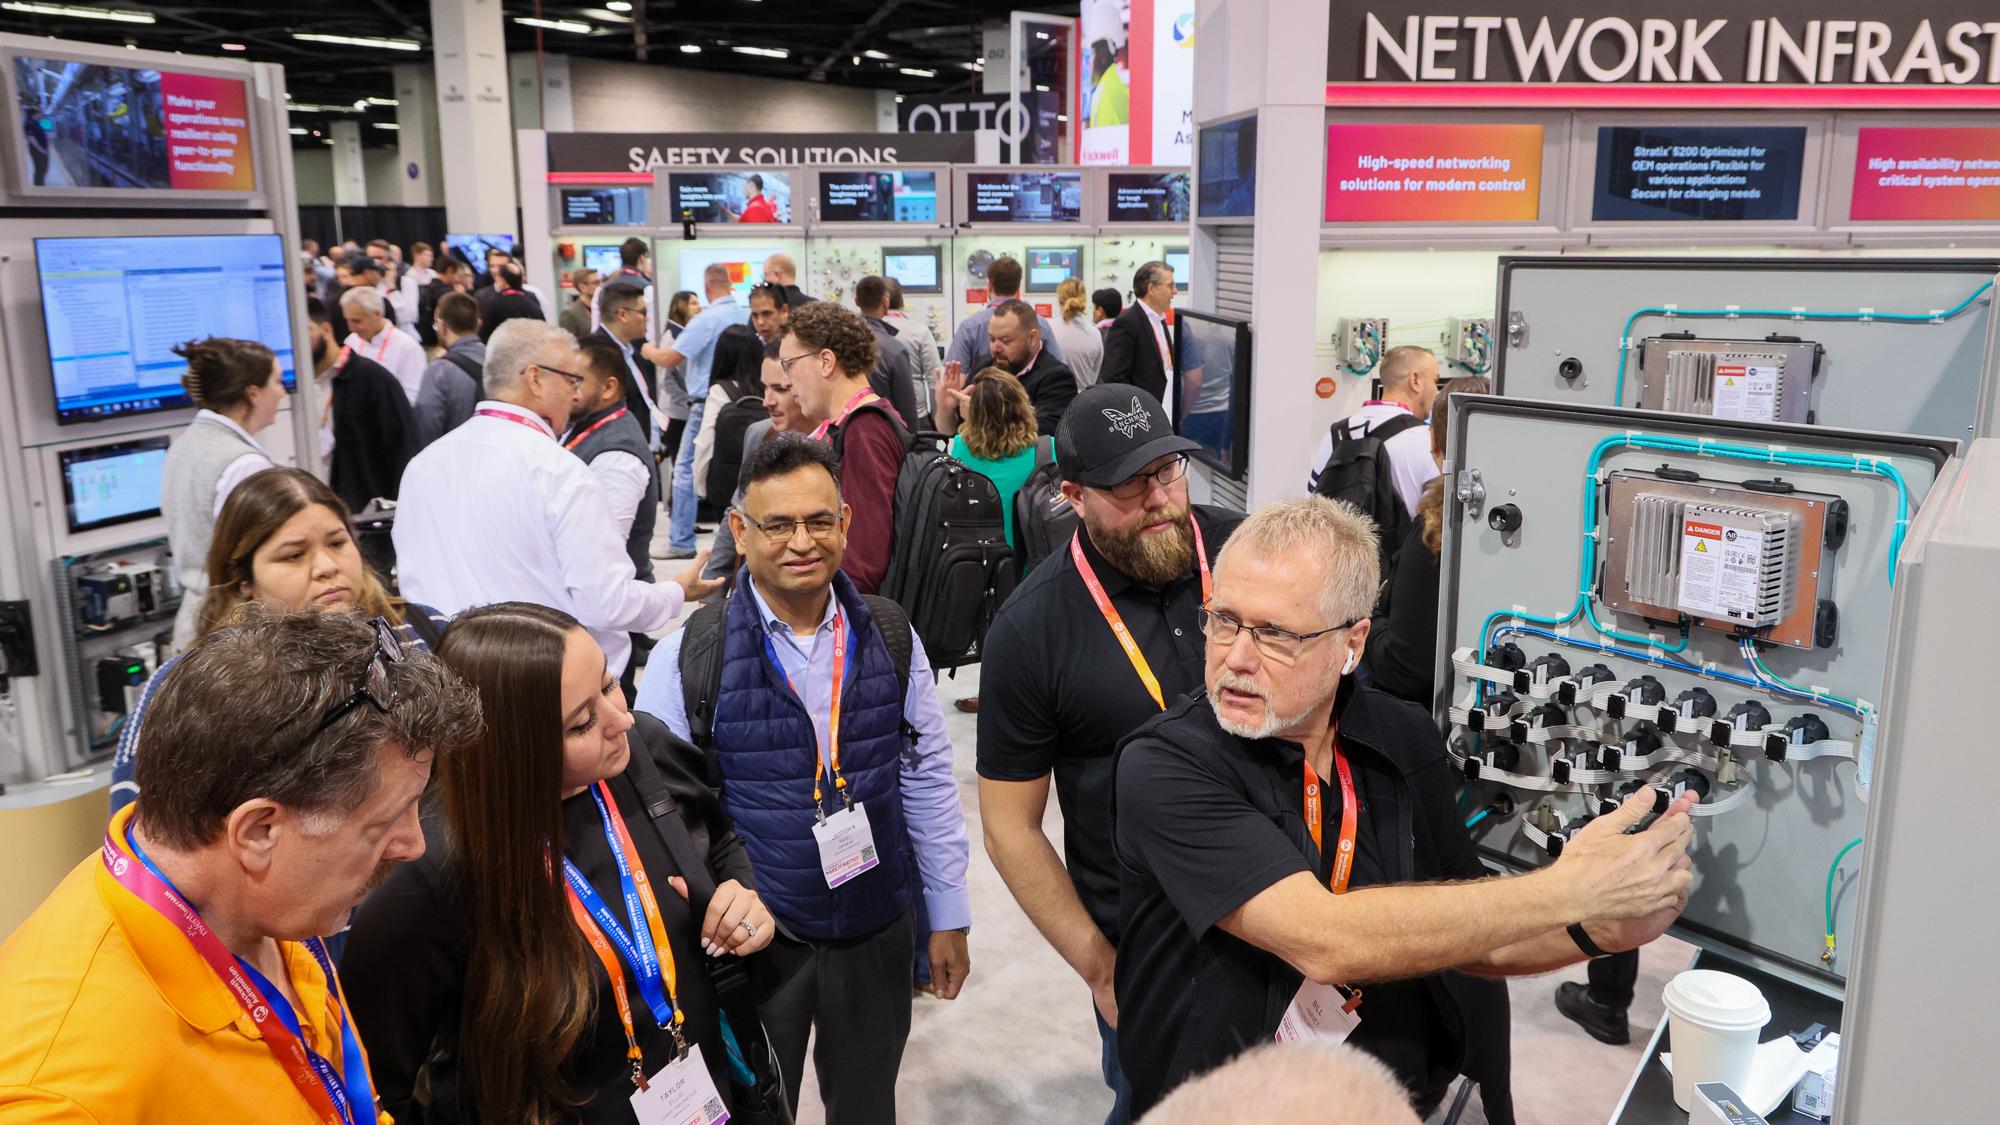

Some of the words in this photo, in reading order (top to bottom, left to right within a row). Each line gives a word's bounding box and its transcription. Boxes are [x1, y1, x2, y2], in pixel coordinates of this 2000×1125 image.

[1365, 11, 1728, 82] NETWORK
[1746, 16, 2000, 84] INFRAST
[908, 100, 1030, 145] OTTO
[629, 147, 730, 173] SAFETY
[739, 146, 898, 165] SOLUTIONS
[1700, 146, 1750, 159] Optimized
[1750, 147, 1766, 157] for
[1358, 155, 1434, 172] High-speed
[1436, 156, 1511, 172] networking
[1632, 160, 1655, 171] OEM
[1655, 161, 1709, 173] operations
[1710, 160, 1749, 171] Flexible
[1750, 161, 1766, 171] for
[1869, 157, 1896, 172] High
[1897, 157, 1961, 172] availability
[1340, 178, 1401, 191] solutions
[1404, 178, 1424, 191] for
[1426, 178, 1476, 191] modern
[1478, 178, 1526, 191] control
[1648, 175, 1685, 185] various
[1686, 174, 1747, 186] applications
[1878, 174, 1922, 186] critical
[1923, 175, 1965, 188] system
[1631, 188, 1667, 199] Secure
[1668, 188, 1682, 199] for
[1684, 188, 1729, 201] changing
[1730, 188, 1761, 199] needs
[1694, 526, 1721, 536] DANGER
[228, 966, 260, 1004] Automation
[230, 979, 254, 1009] Rockwell
[1312, 1000, 1324, 1017] BILL
[660, 1078, 685, 1102] TAYLOR
